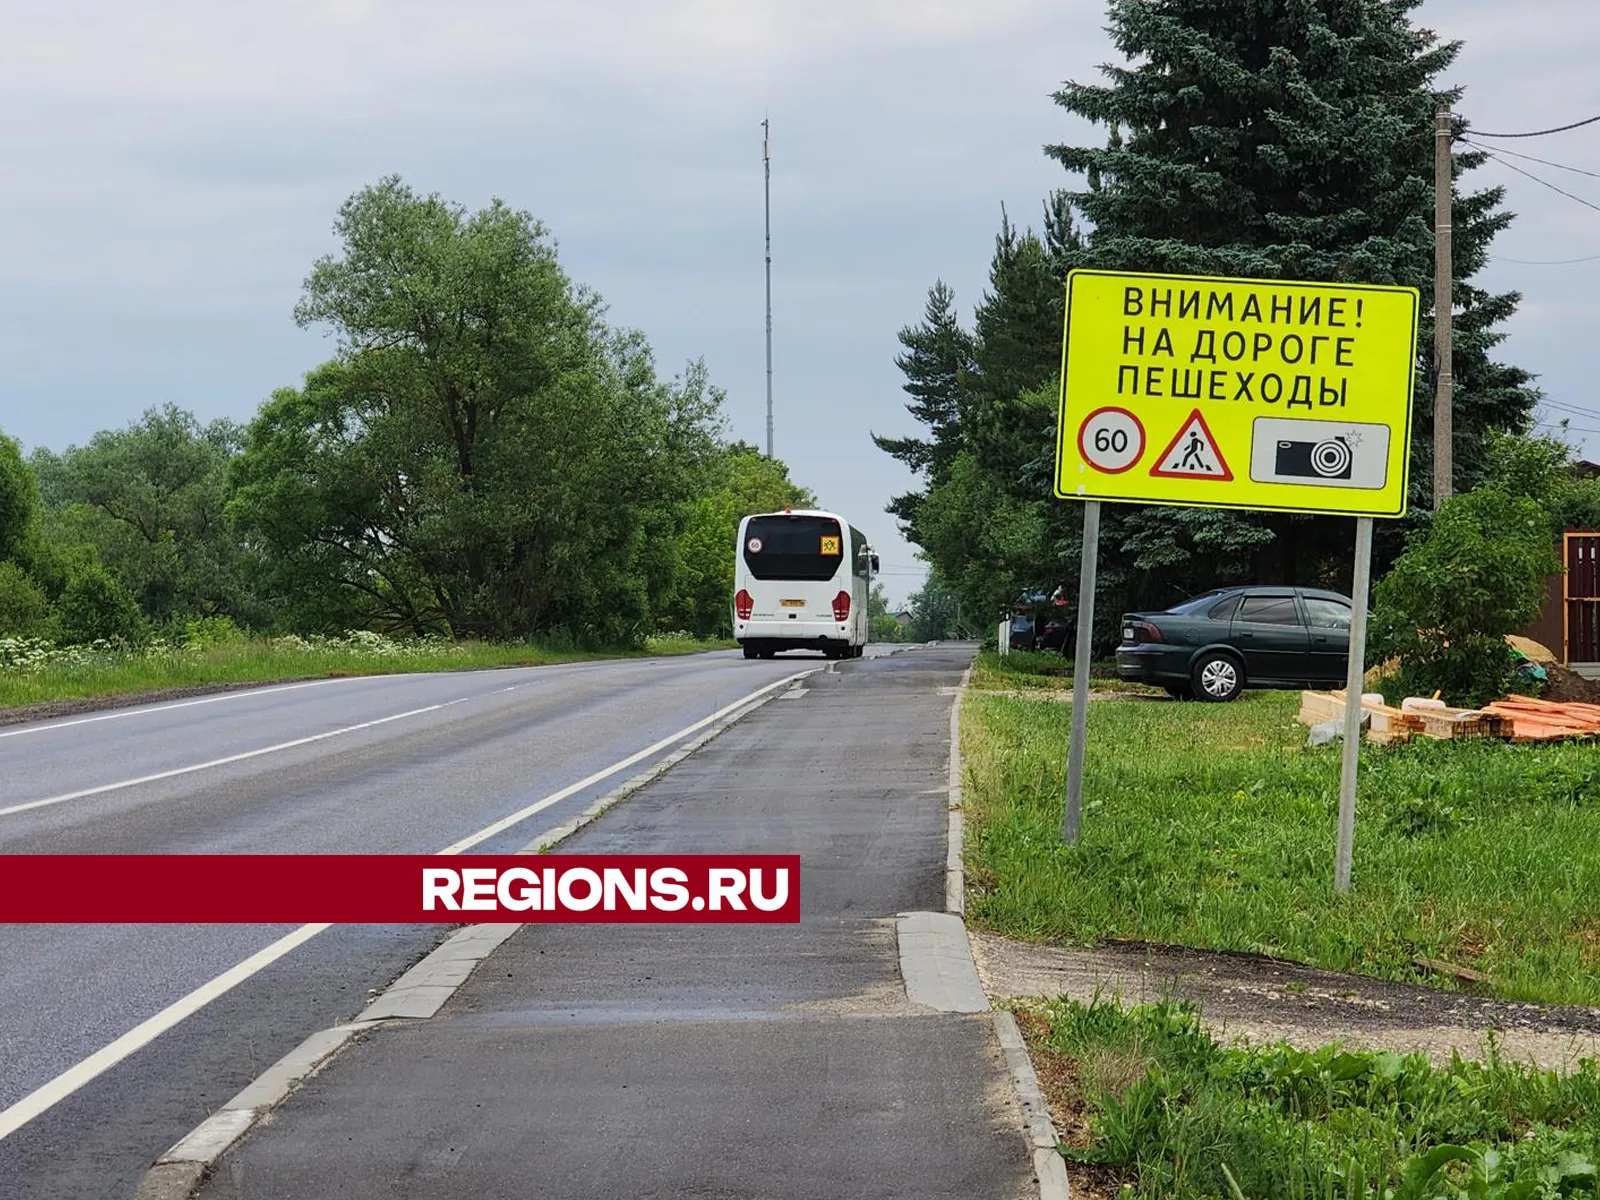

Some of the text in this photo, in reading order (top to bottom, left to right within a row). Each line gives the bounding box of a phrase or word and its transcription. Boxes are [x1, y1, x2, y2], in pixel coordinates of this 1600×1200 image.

[1123, 286, 1364, 328] ВНИМАНИЕ!
[1122, 326, 1356, 367] НА ДОРОГЕ
[1117, 364, 1348, 410] ПЕШЕХОДЫ
[1094, 428, 1128, 453] 60
